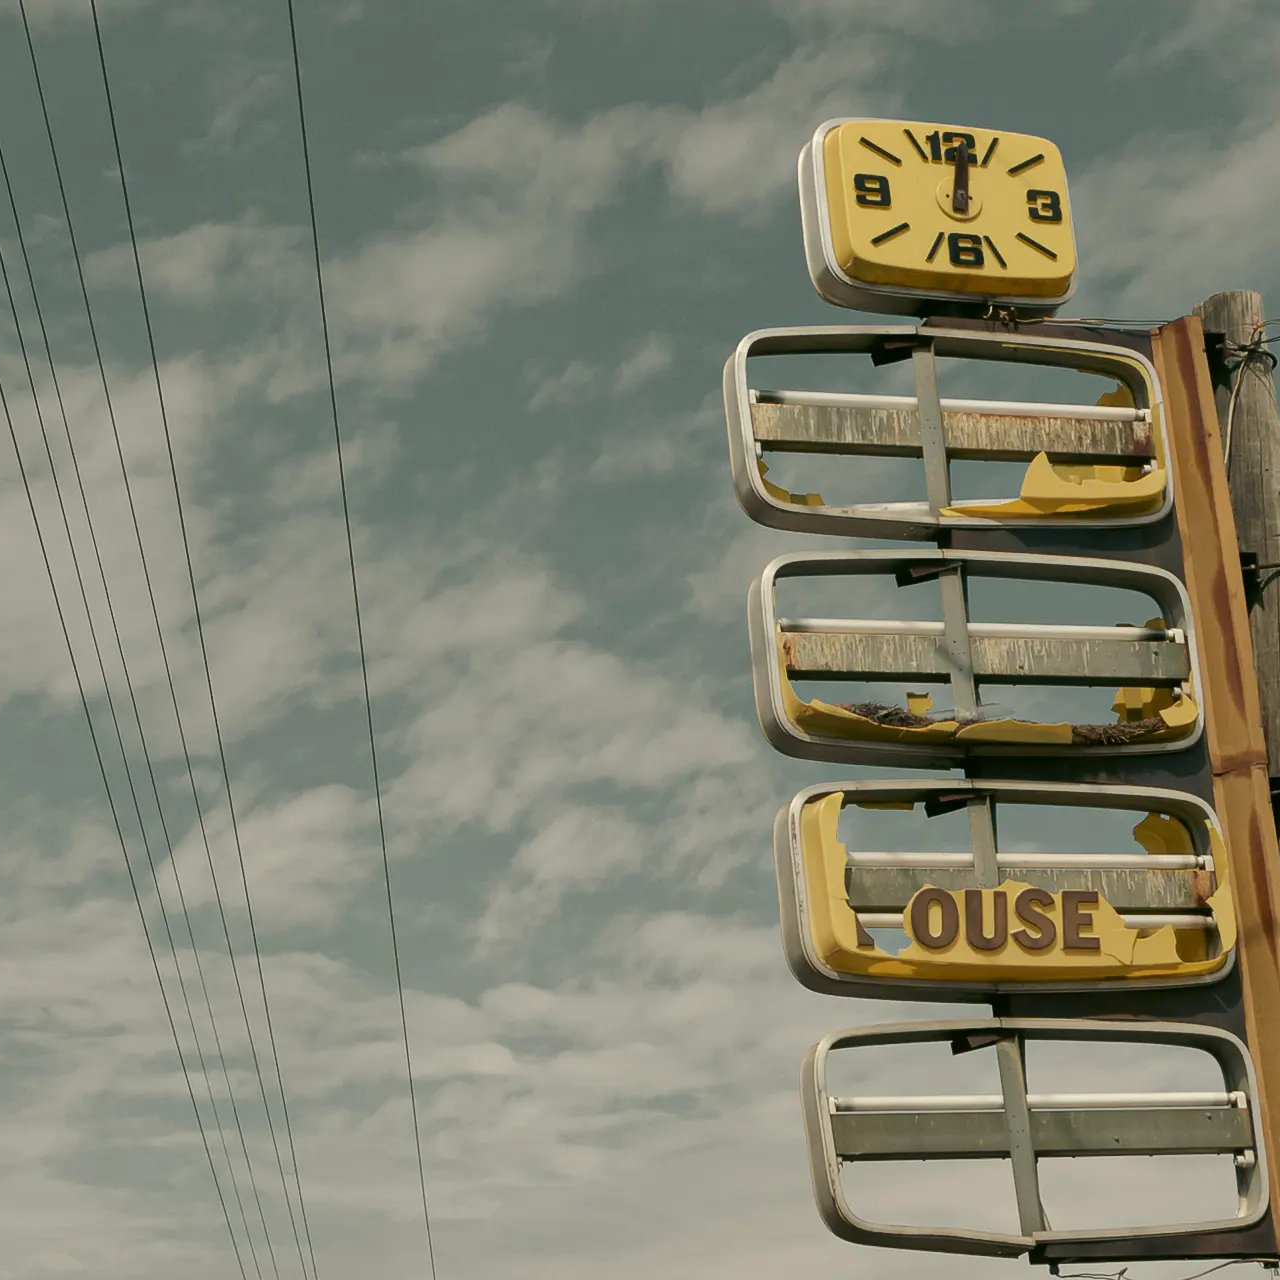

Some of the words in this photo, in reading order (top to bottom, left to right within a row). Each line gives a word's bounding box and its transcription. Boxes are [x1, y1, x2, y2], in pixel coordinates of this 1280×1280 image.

[926, 131, 979, 165] 12
[853, 173, 892, 207] 9
[1025, 189, 1063, 222] 3
[947, 232, 985, 267] 6
[855, 887, 1101, 951] OUSE
